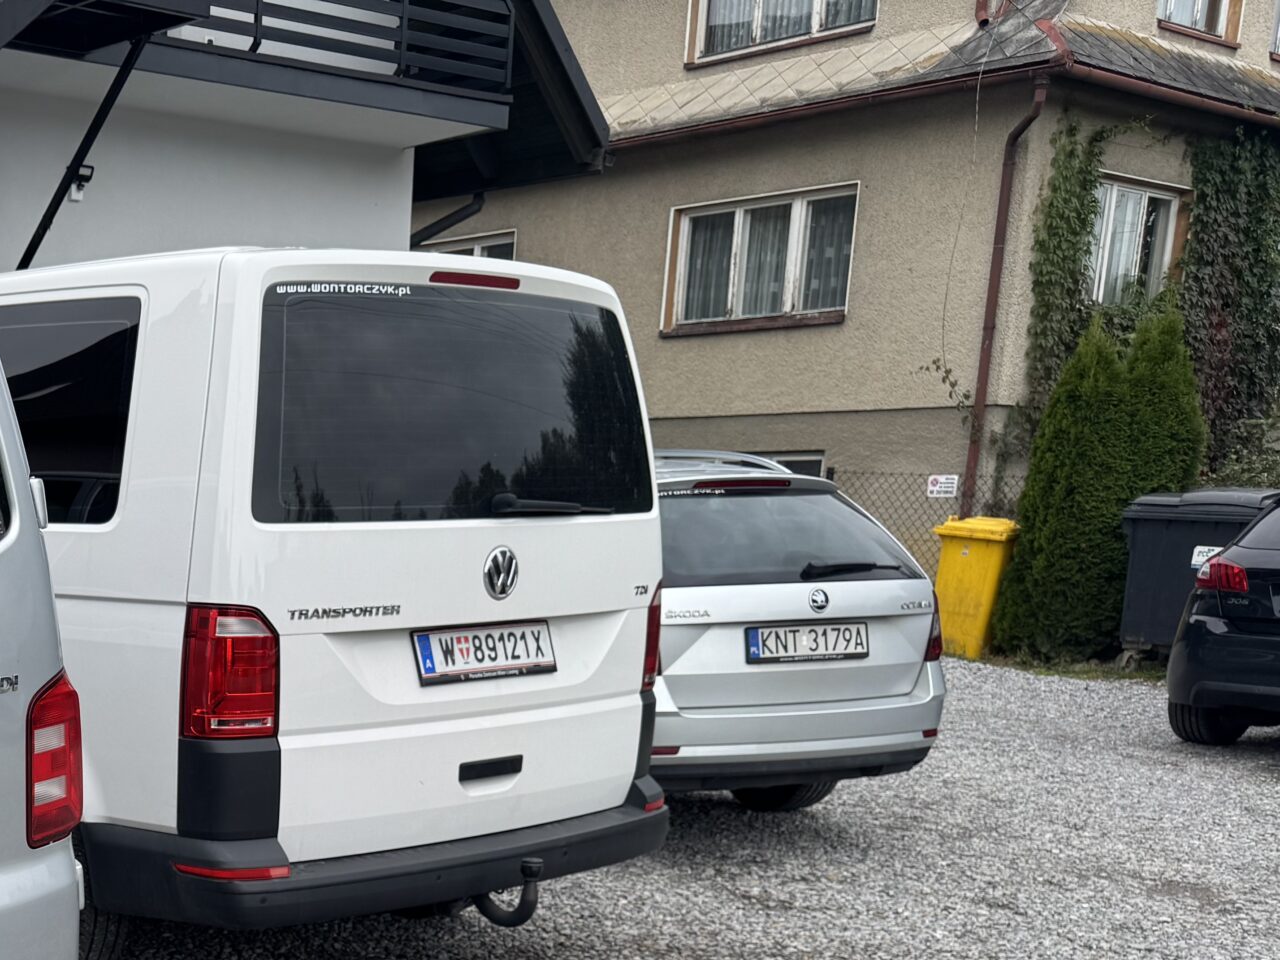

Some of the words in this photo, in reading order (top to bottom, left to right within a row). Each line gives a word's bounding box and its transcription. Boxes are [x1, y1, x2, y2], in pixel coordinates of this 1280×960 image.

[634, 585, 648, 596] TDI
[287, 604, 401, 621] TRANSPORTER
[438, 636, 456, 667] W
[472, 630, 545, 663] 89121X
[761, 629, 800, 655] KNT
[808, 626, 865, 652] 3179A
